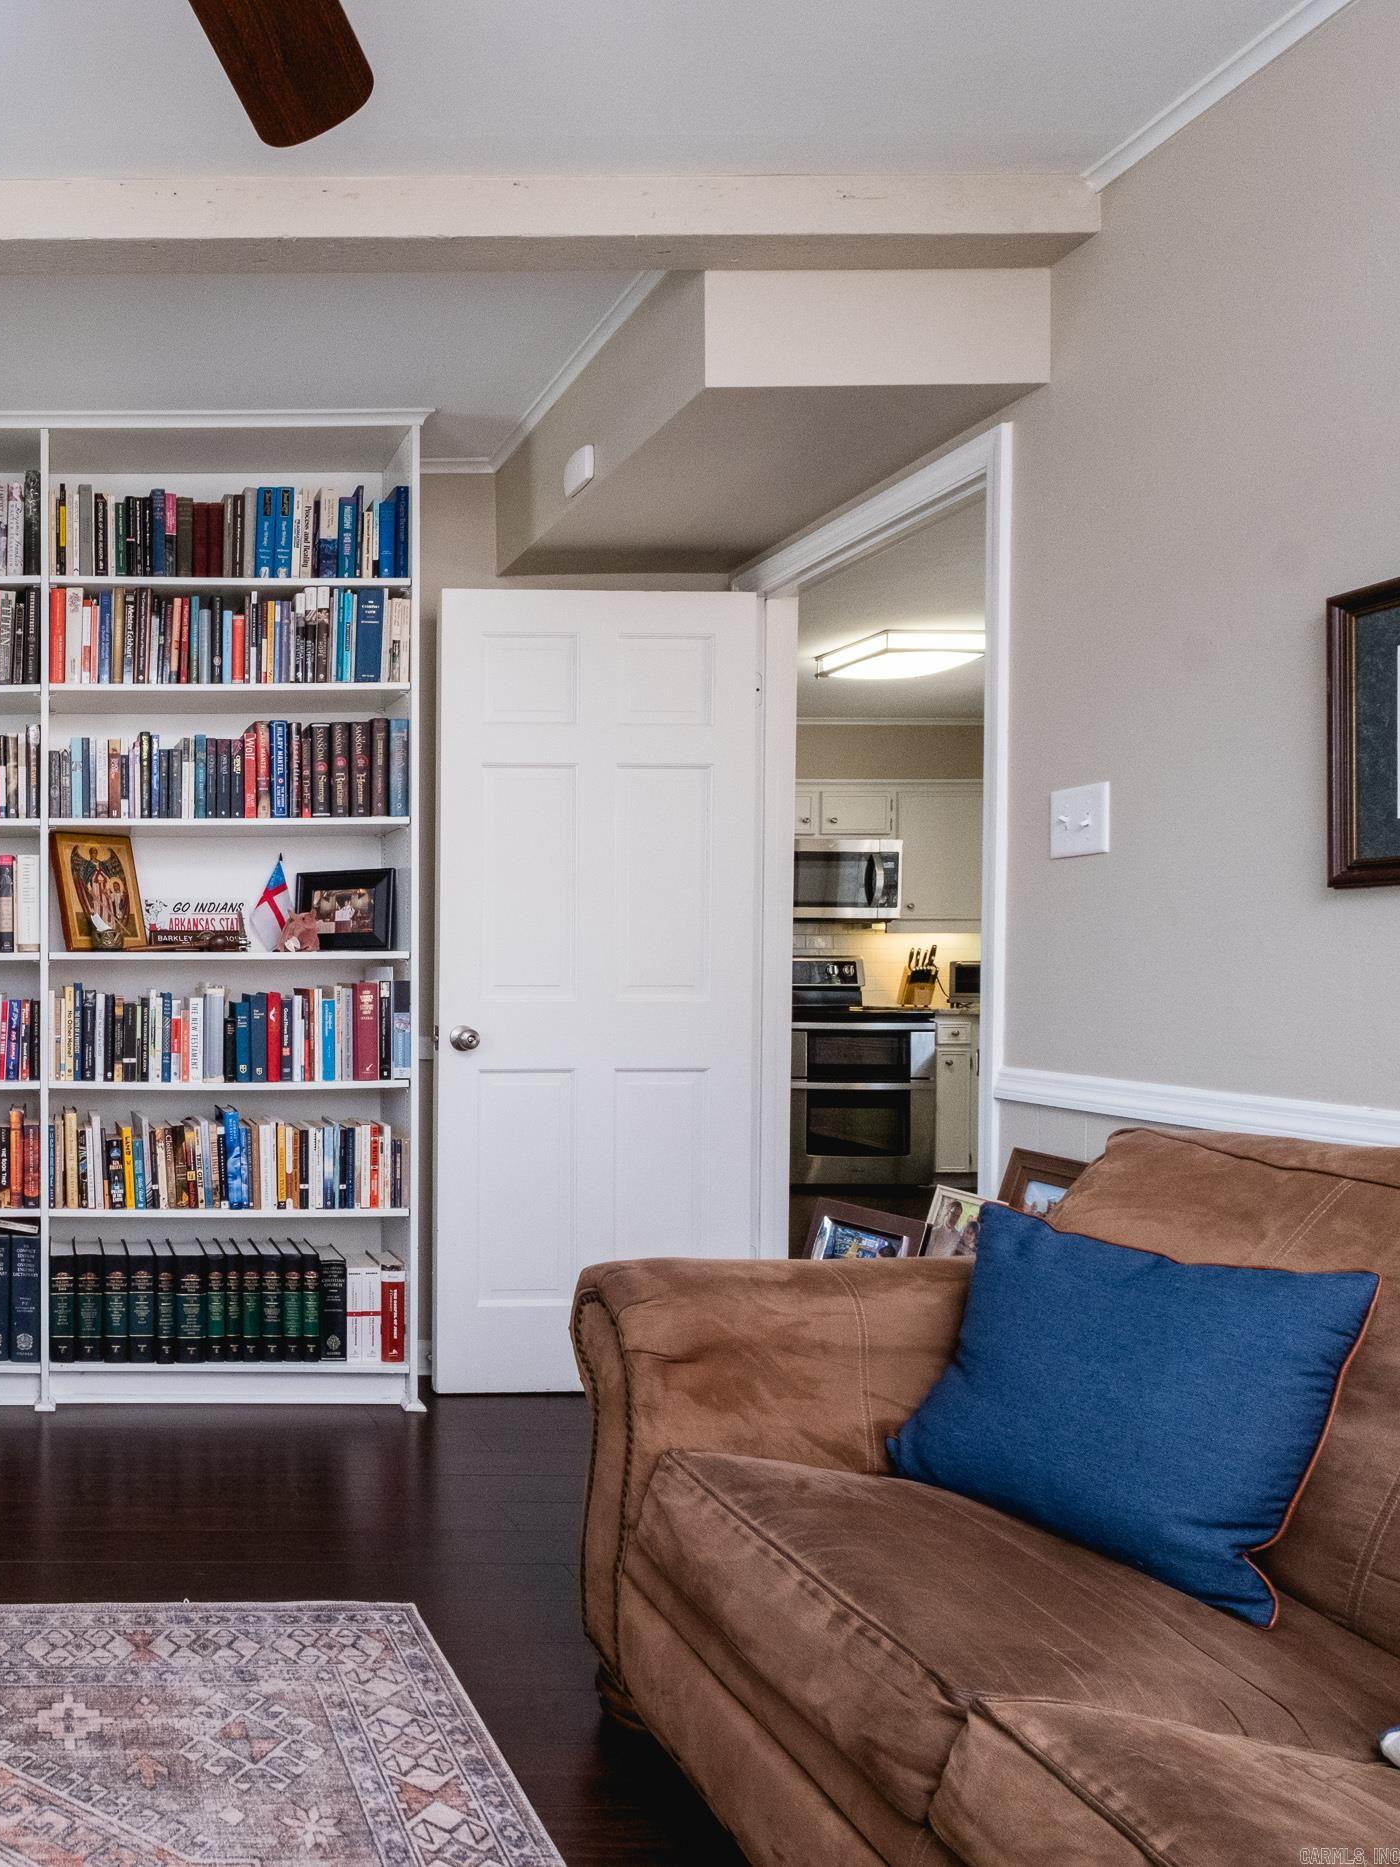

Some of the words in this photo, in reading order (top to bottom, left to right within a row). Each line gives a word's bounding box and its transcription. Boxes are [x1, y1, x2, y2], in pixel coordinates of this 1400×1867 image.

[303, 505, 312, 530] Process
[303, 531, 311, 544] and
[301, 545, 311, 568] Reality
[0, 605, 12, 647] TITAN
[126, 604, 135, 630] Meister
[125, 630, 134, 659] Eckhart
[244, 737, 255, 761] Wolf
[315, 728, 325, 761] SANSOM
[334, 724, 343, 755] SANSOM
[354, 724, 363, 755] SANSOM
[393, 730, 407, 768] Tombland
[316, 774, 327, 803] Sovereign
[334, 772, 346, 806] Revelation
[355, 771, 367, 806] Heartstone
[22, 855, 36, 904] Churchill
[172, 902, 191, 913] GO
[194, 902, 245, 914] INDIANS
[157, 934, 193, 942] BARKLEY
[168, 917, 216, 931] ARKANSAS
[66, 1010, 74, 1018] No
[165, 1134, 174, 1162] Cloister
